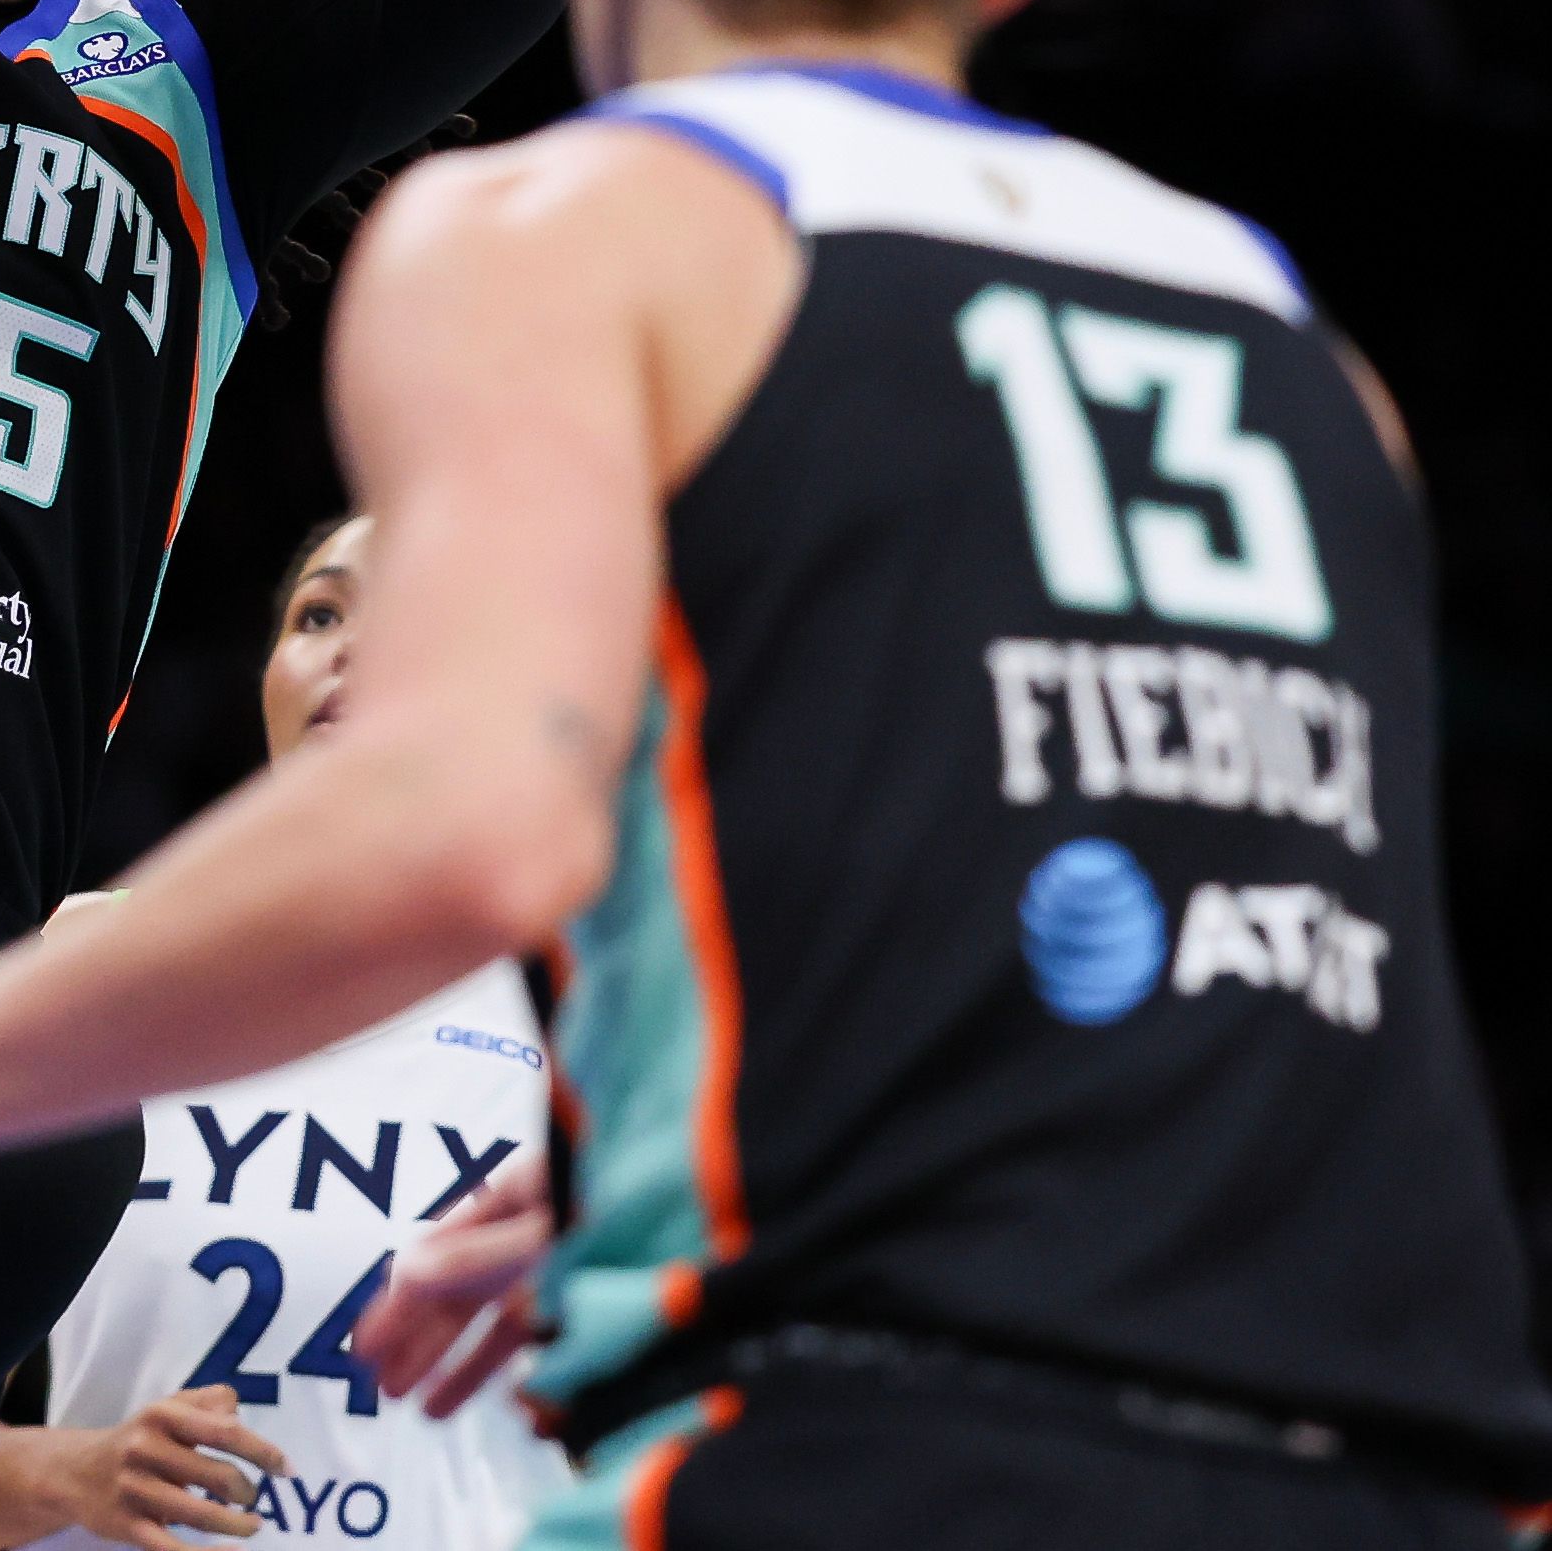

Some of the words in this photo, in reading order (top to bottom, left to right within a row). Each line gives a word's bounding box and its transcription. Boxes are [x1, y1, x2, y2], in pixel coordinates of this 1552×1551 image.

[61, 44, 167, 85] BARCLAYS
[955, 281, 1337, 644] 13
[205, 1474, 389, 1538] AYO
